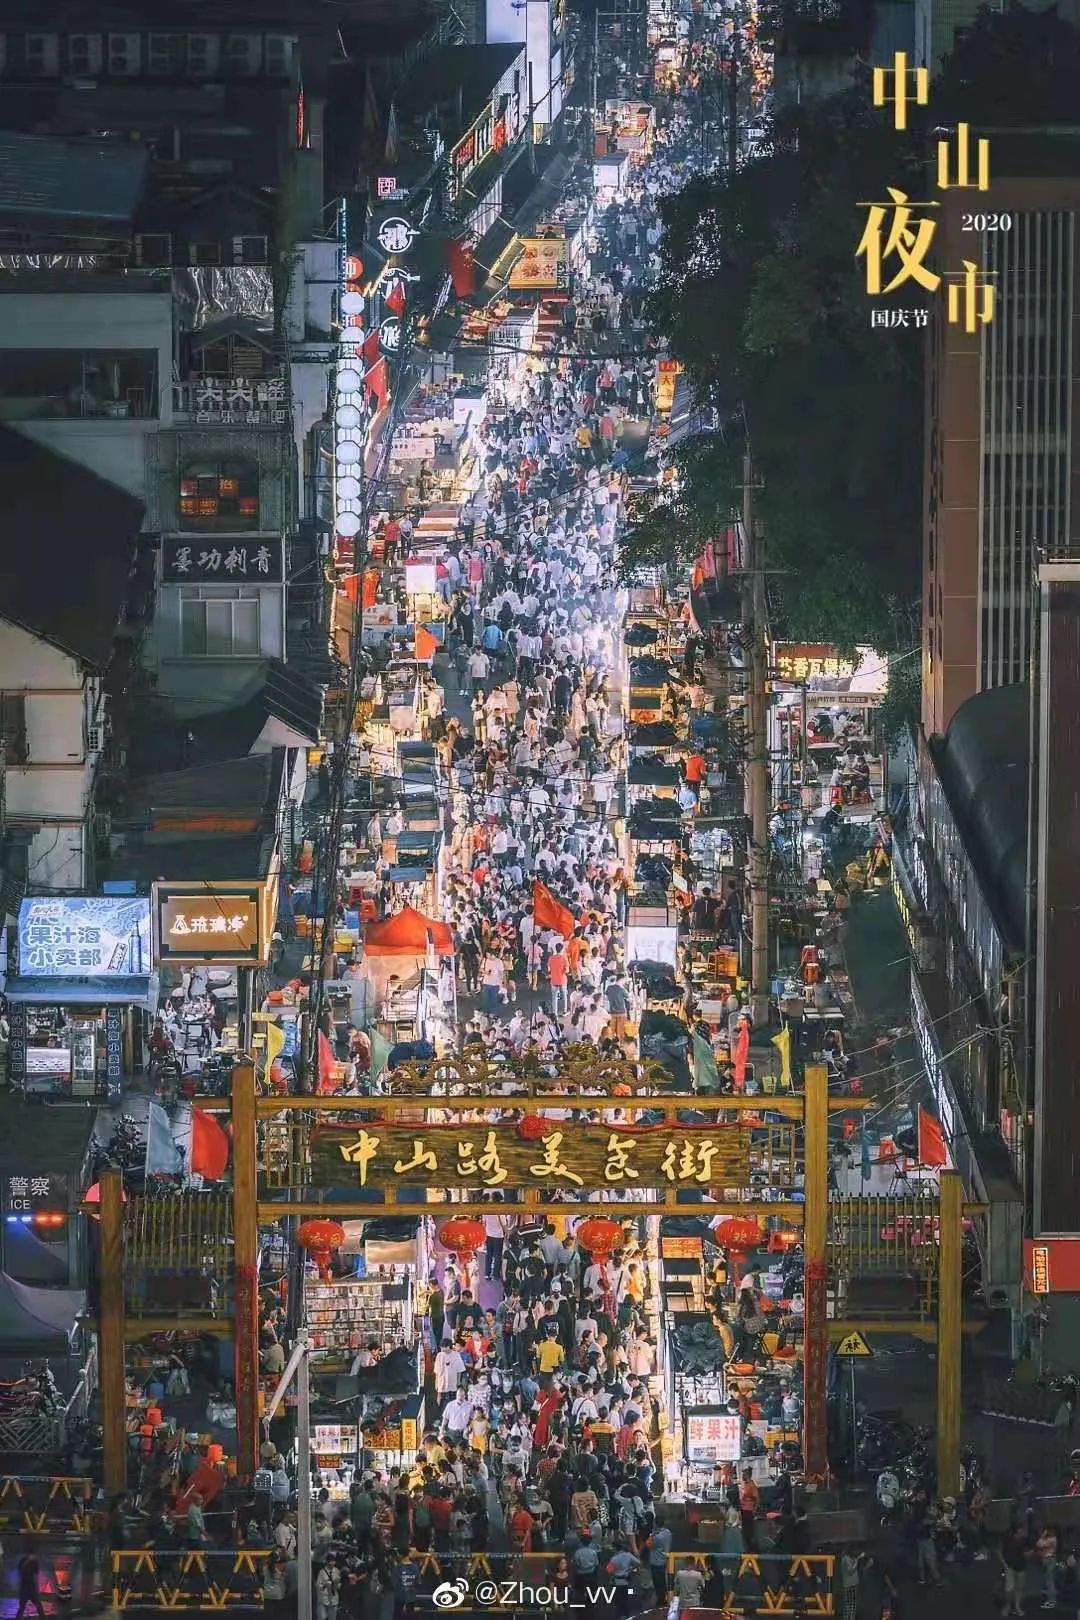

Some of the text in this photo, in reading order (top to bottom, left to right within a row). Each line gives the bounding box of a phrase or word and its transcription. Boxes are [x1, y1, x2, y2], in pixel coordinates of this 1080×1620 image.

[171, 545, 272, 574] 墨功刺青
[29, 925, 101, 945] 果汁海
[29, 948, 101, 967] 小卖部
[338, 1129, 720, 1186] 中山路美食街
[9, 1176, 50, 1197] 警察
[689, 1418, 738, 1441] 鲜果汁
